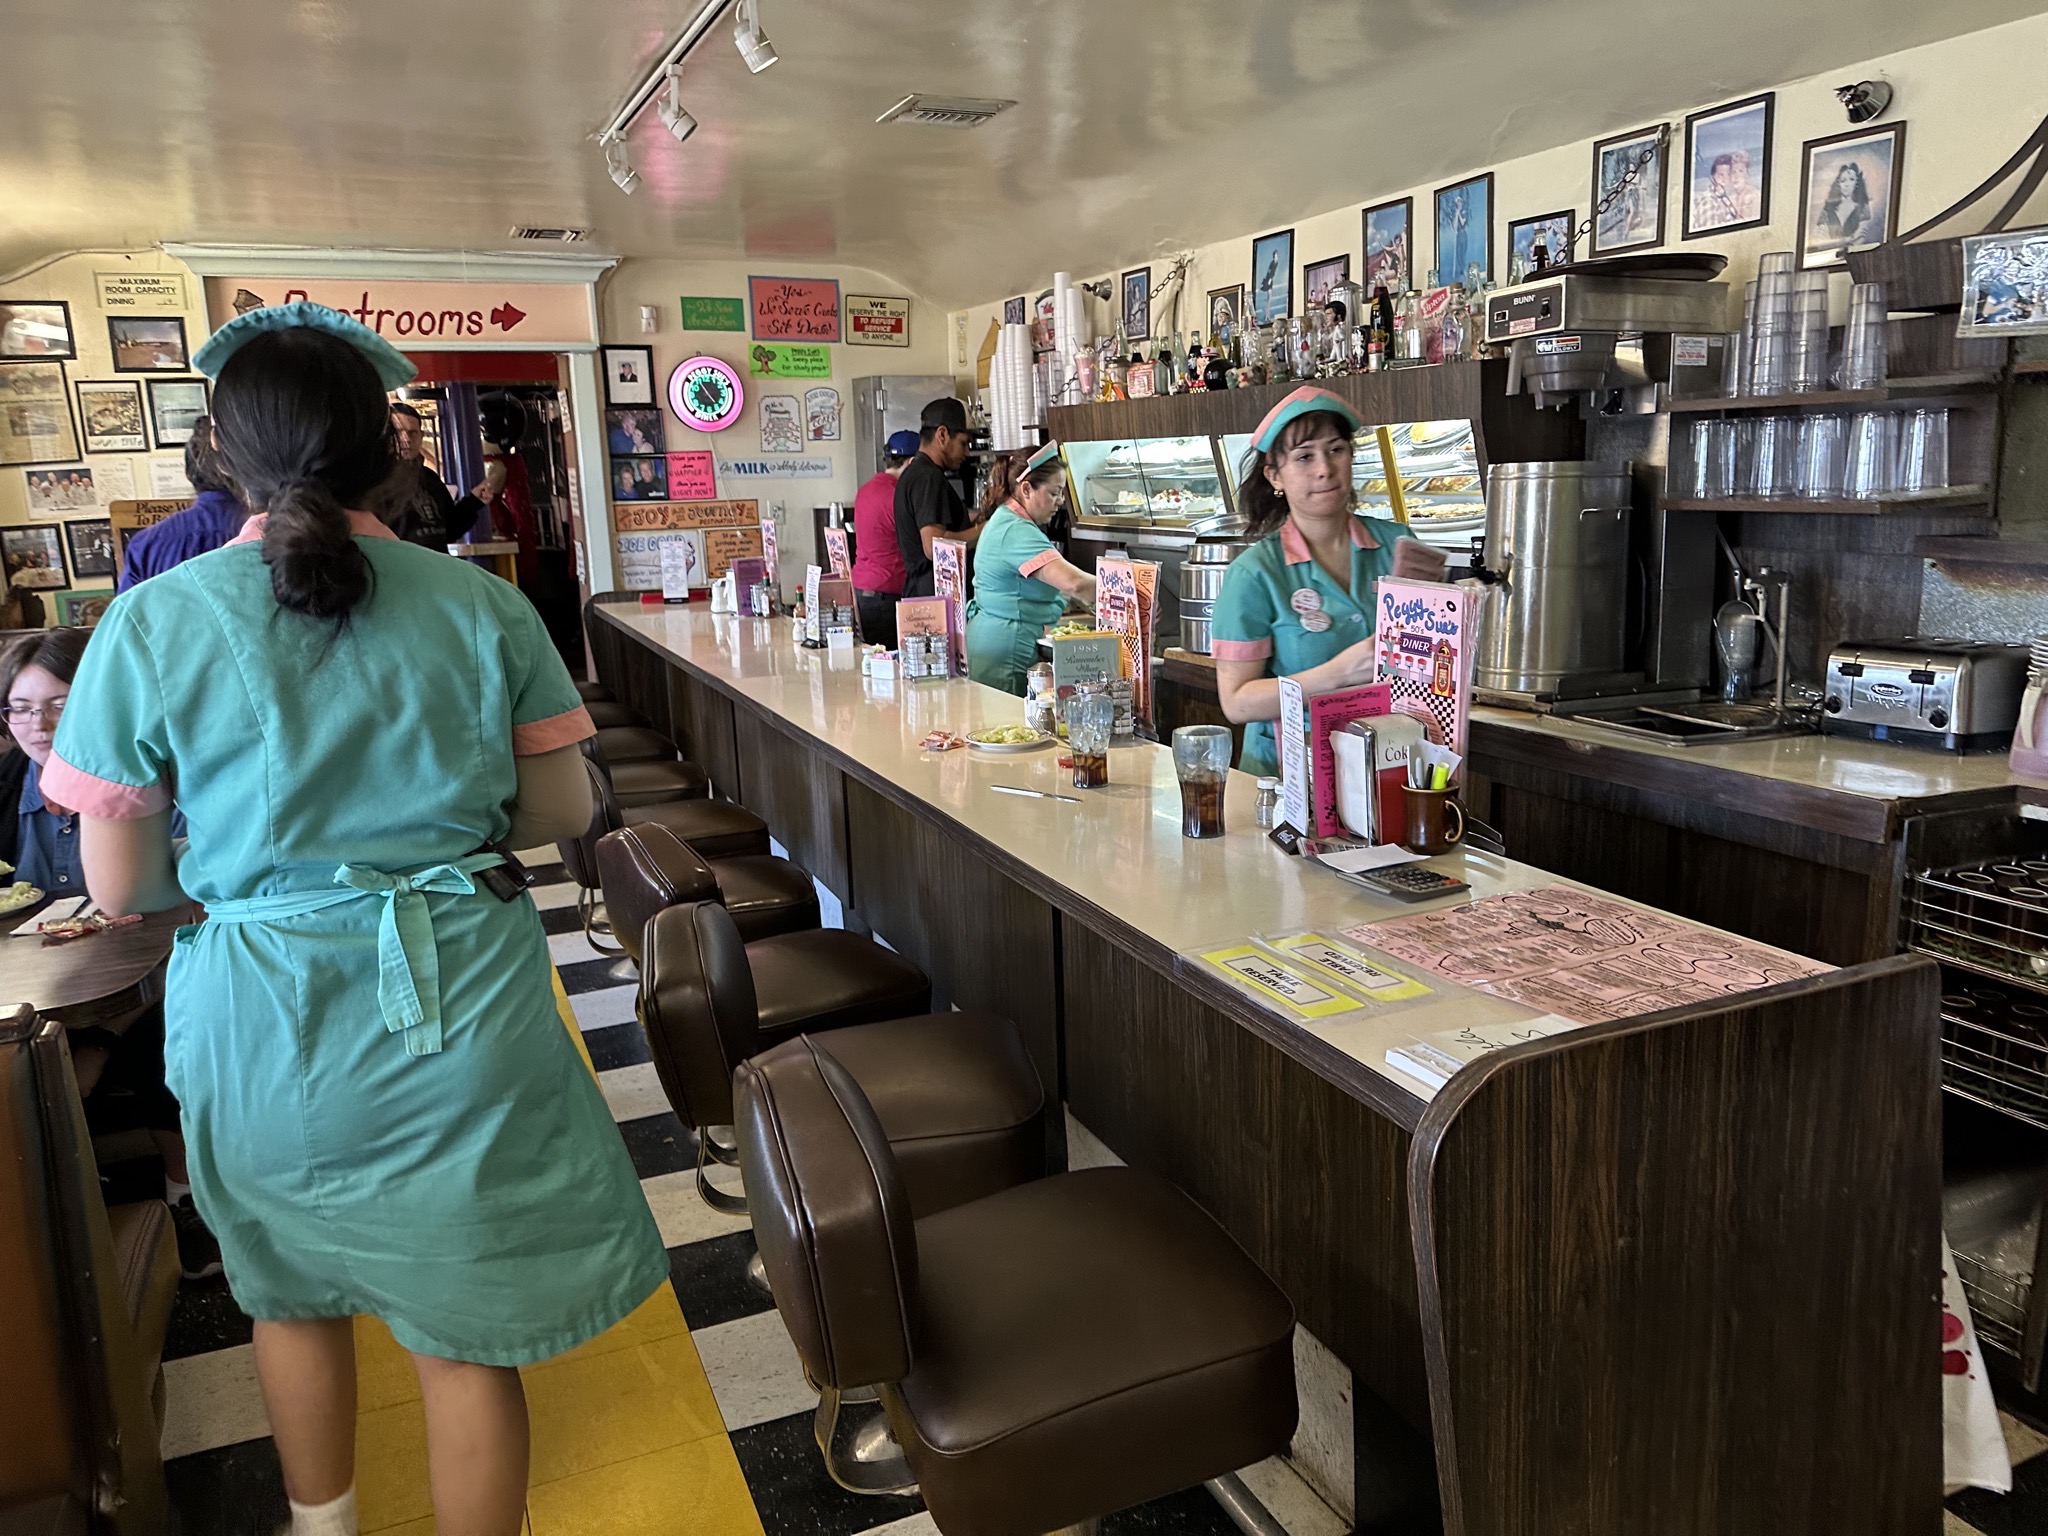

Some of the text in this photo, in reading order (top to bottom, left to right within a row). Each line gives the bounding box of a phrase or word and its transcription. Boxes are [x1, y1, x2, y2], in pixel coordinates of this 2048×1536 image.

[135, 286, 176, 294] CAPACITY
[1421, 292, 1446, 314] Lipton
[1513, 295, 1535, 305] BUNN
[849, 308, 874, 316] RESERVE
[687, 367, 712, 381] PEGGY
[674, 469, 702, 477] HAPPIER
[734, 462, 770, 474] MILK
[672, 489, 693, 497] RIGHT
[136, 503, 173, 514] Please
[135, 515, 150, 526] To
[633, 506, 669, 526] JOY
[1100, 567, 1120, 589] Peggy
[1110, 597, 1125, 608] DINER
[1383, 593, 1458, 635] Peggy Sue's
[1410, 624, 1425, 634] 50's
[1073, 644, 1098, 653] 1988
[1402, 638, 1430, 652] DINER
[1063, 655, 1106, 665] Remember
[1385, 745, 1407, 762] Cok
[1319, 957, 1354, 976] TABLE
[1324, 950, 1382, 978] RESERVED
[1241, 967, 1297, 995] RESERVED
[1266, 968, 1303, 987] TABLE
